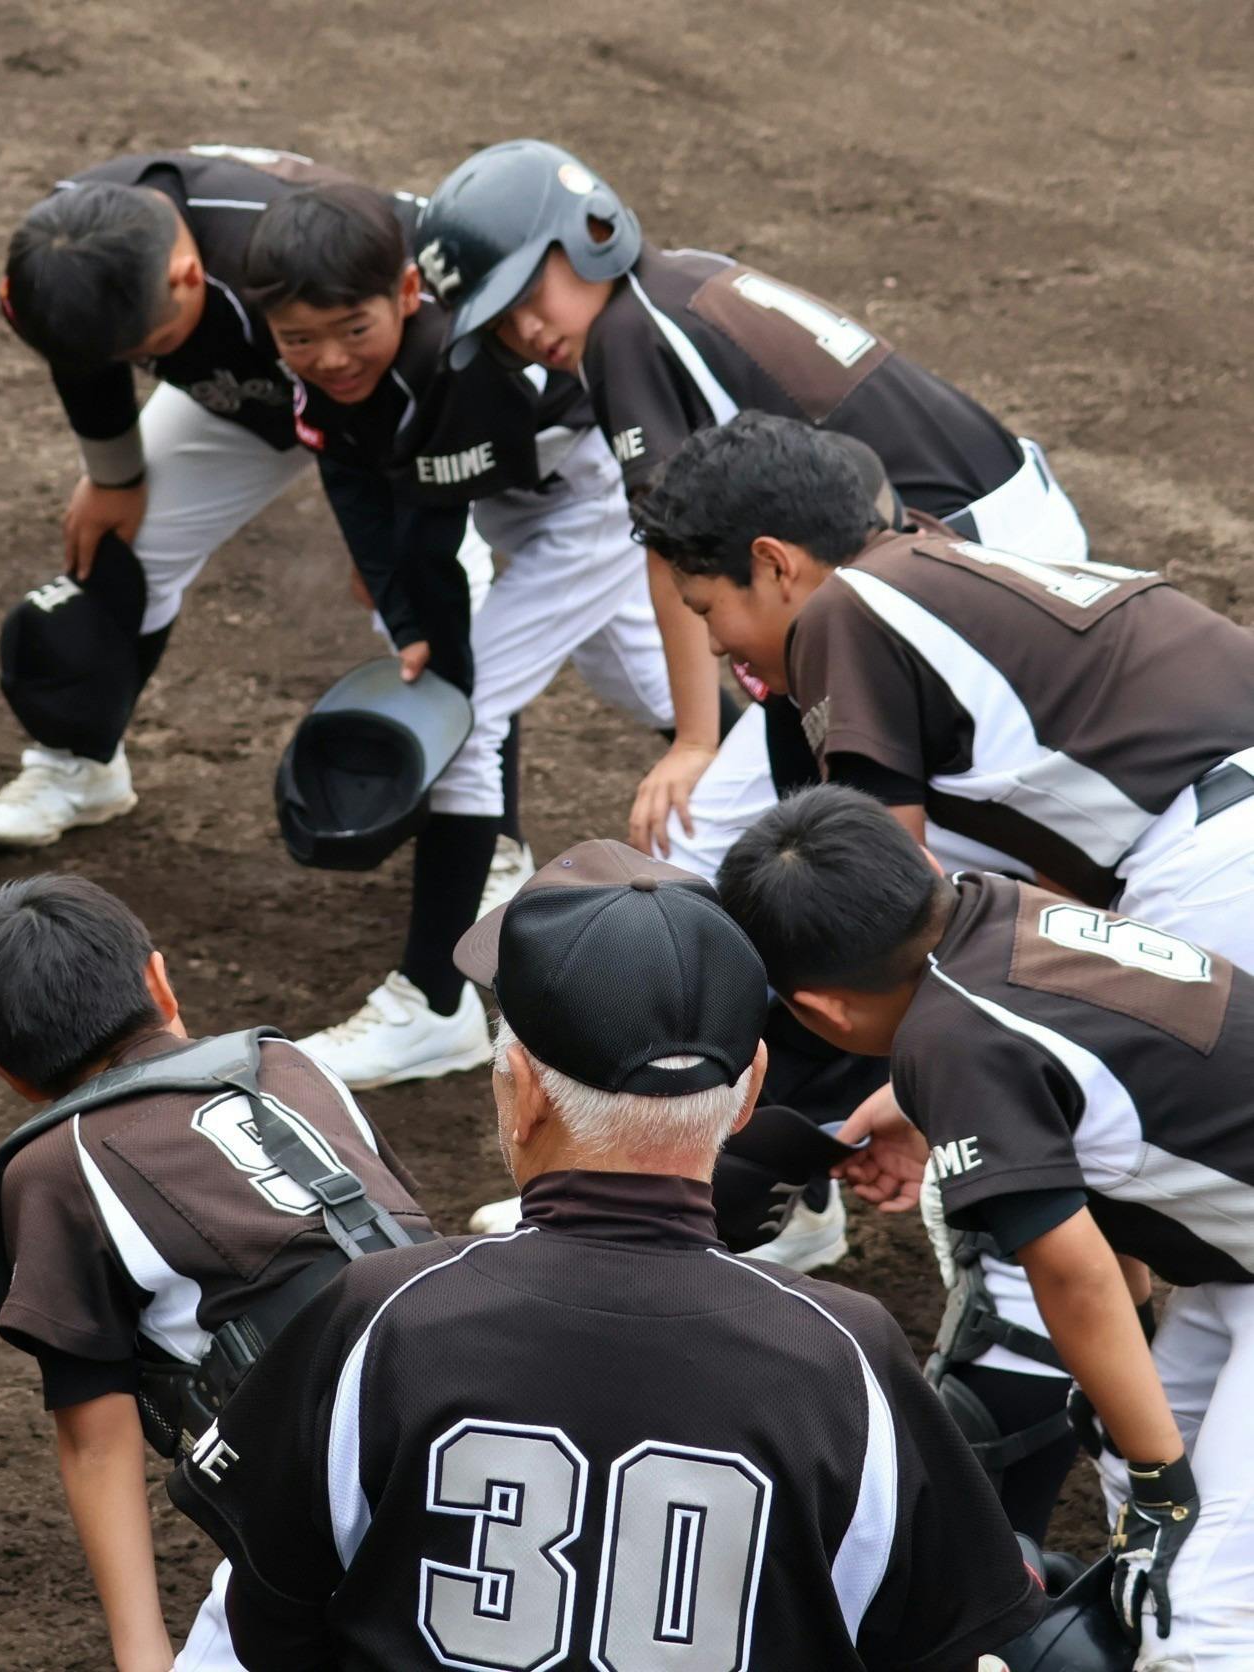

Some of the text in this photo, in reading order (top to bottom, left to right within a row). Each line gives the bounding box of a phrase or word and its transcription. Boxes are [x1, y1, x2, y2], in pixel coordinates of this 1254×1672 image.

[416, 441, 496, 484] EHIME
[612, 426, 646, 465] ME
[1039, 904, 1212, 982] 6
[932, 1136, 983, 1178] ME
[192, 1416, 240, 1484] ME
[417, 1417, 773, 1672] 30
